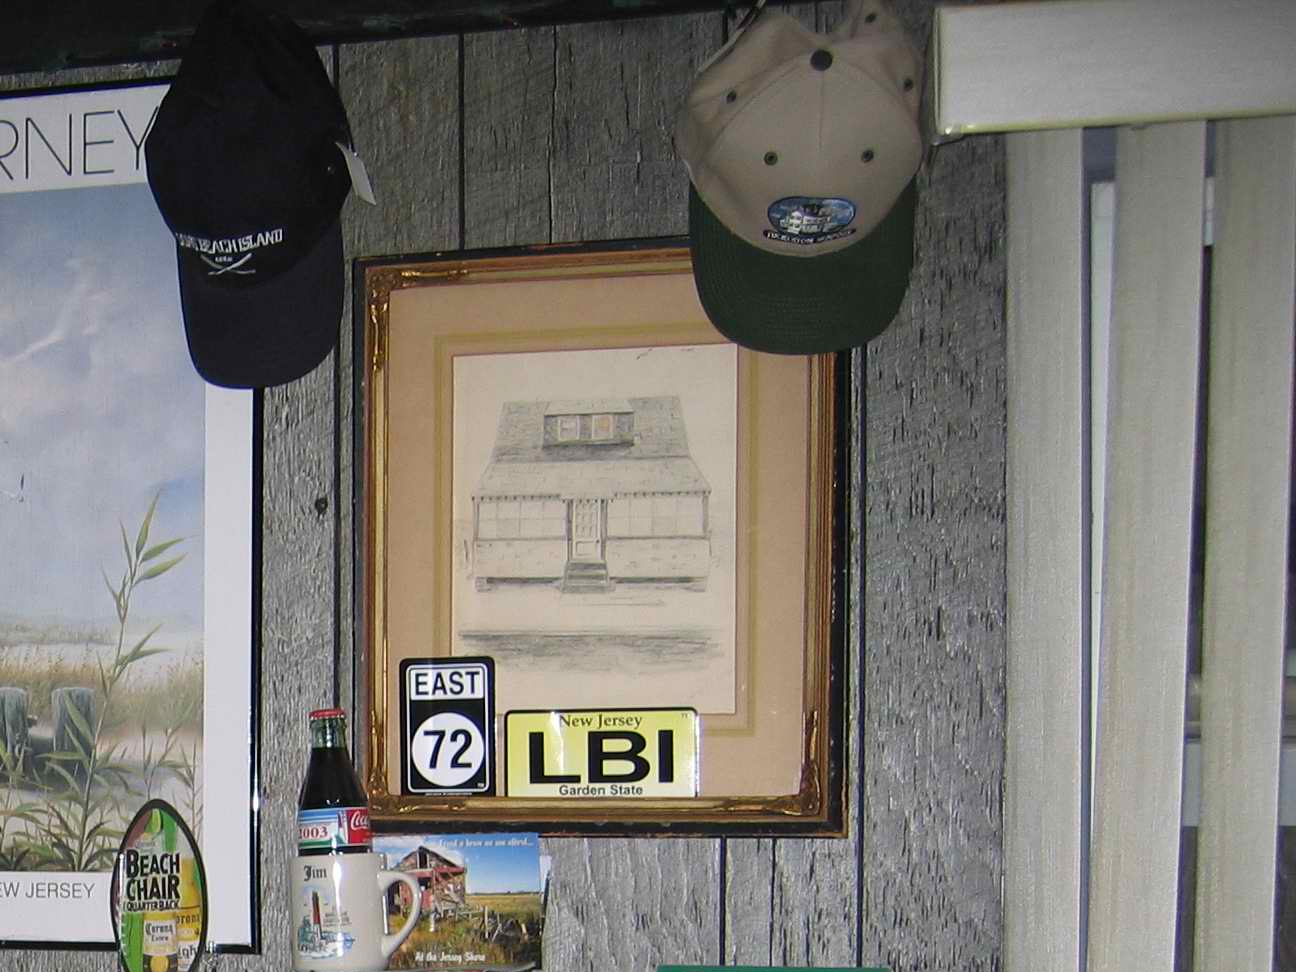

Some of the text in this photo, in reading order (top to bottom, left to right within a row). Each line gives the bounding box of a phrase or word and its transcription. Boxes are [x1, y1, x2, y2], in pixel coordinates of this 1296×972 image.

[239, 227, 284, 253] ISLAND
[414, 671, 481, 696] EAST
[558, 713, 644, 730] New Jersey
[423, 728, 473, 770] 72
[528, 728, 675, 785] LBI
[558, 784, 644, 797] Garden State
[126, 849, 180, 878] BEACH
[303, 865, 327, 882] Jim
[25, 882, 96, 899] JERSEY
[126, 875, 180, 902] CHAIR
[426, 952, 437, 961] the
[439, 952, 462, 963] Jersey
[465, 952, 486, 962] Shore
